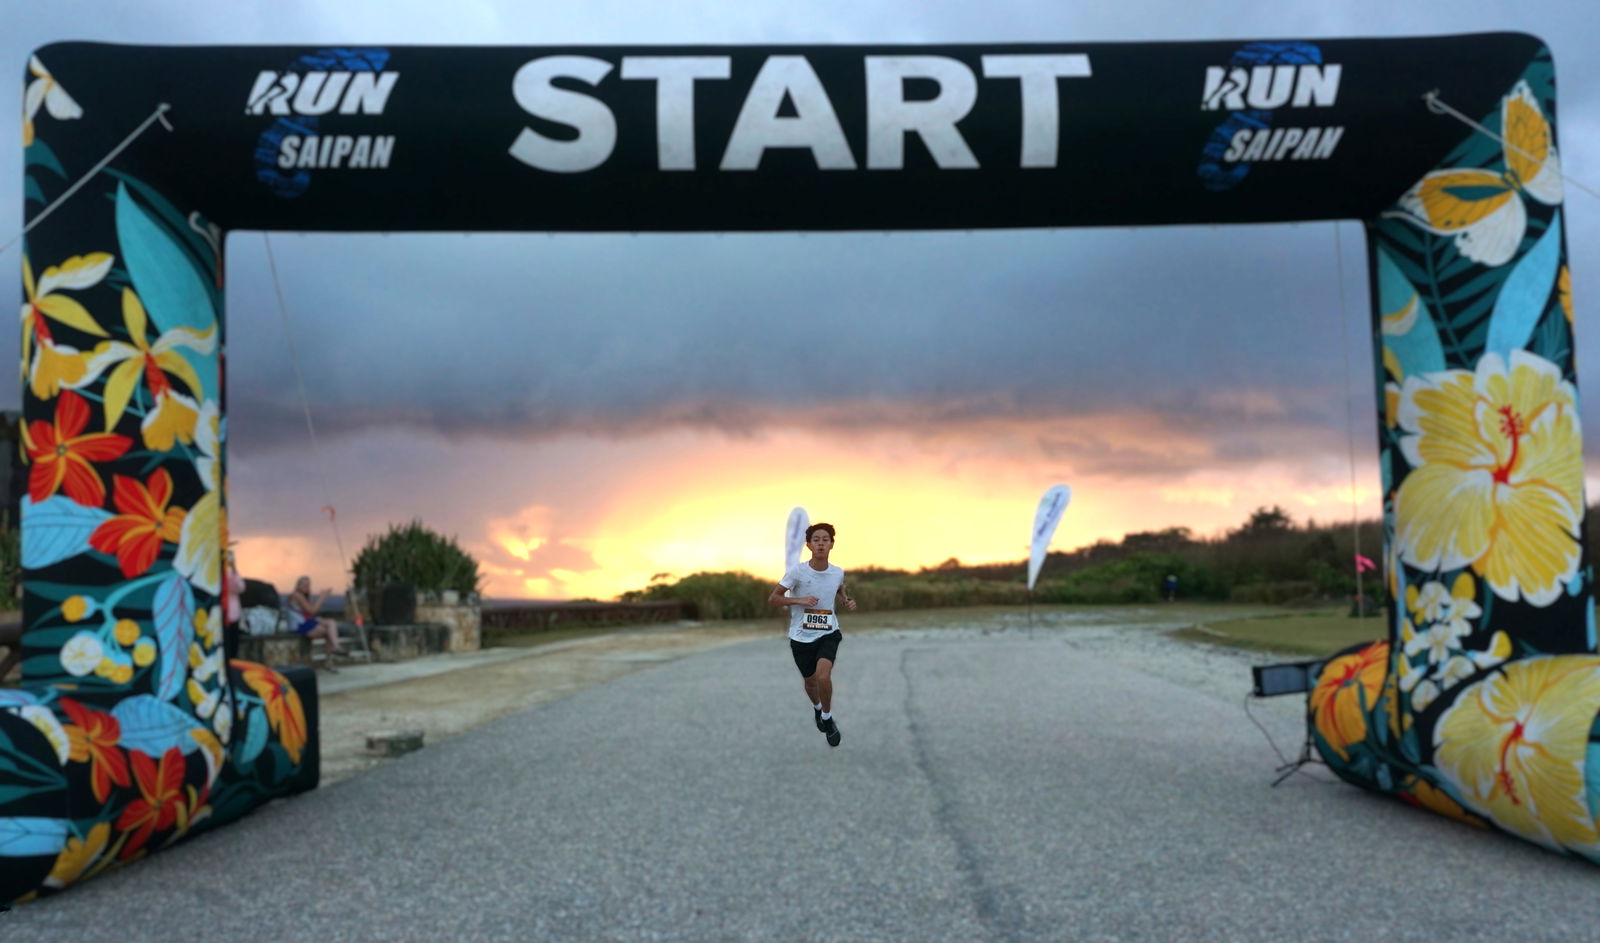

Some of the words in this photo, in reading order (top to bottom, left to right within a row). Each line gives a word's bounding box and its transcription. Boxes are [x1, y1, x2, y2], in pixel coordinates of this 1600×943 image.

[245, 70, 399, 116] RUN
[1200, 64, 1342, 111] RUN
[508, 53, 1092, 173] START
[277, 134, 396, 169] SAIPAN
[1224, 126, 1345, 162] SAIPAN
[807, 614, 828, 624] 0963
